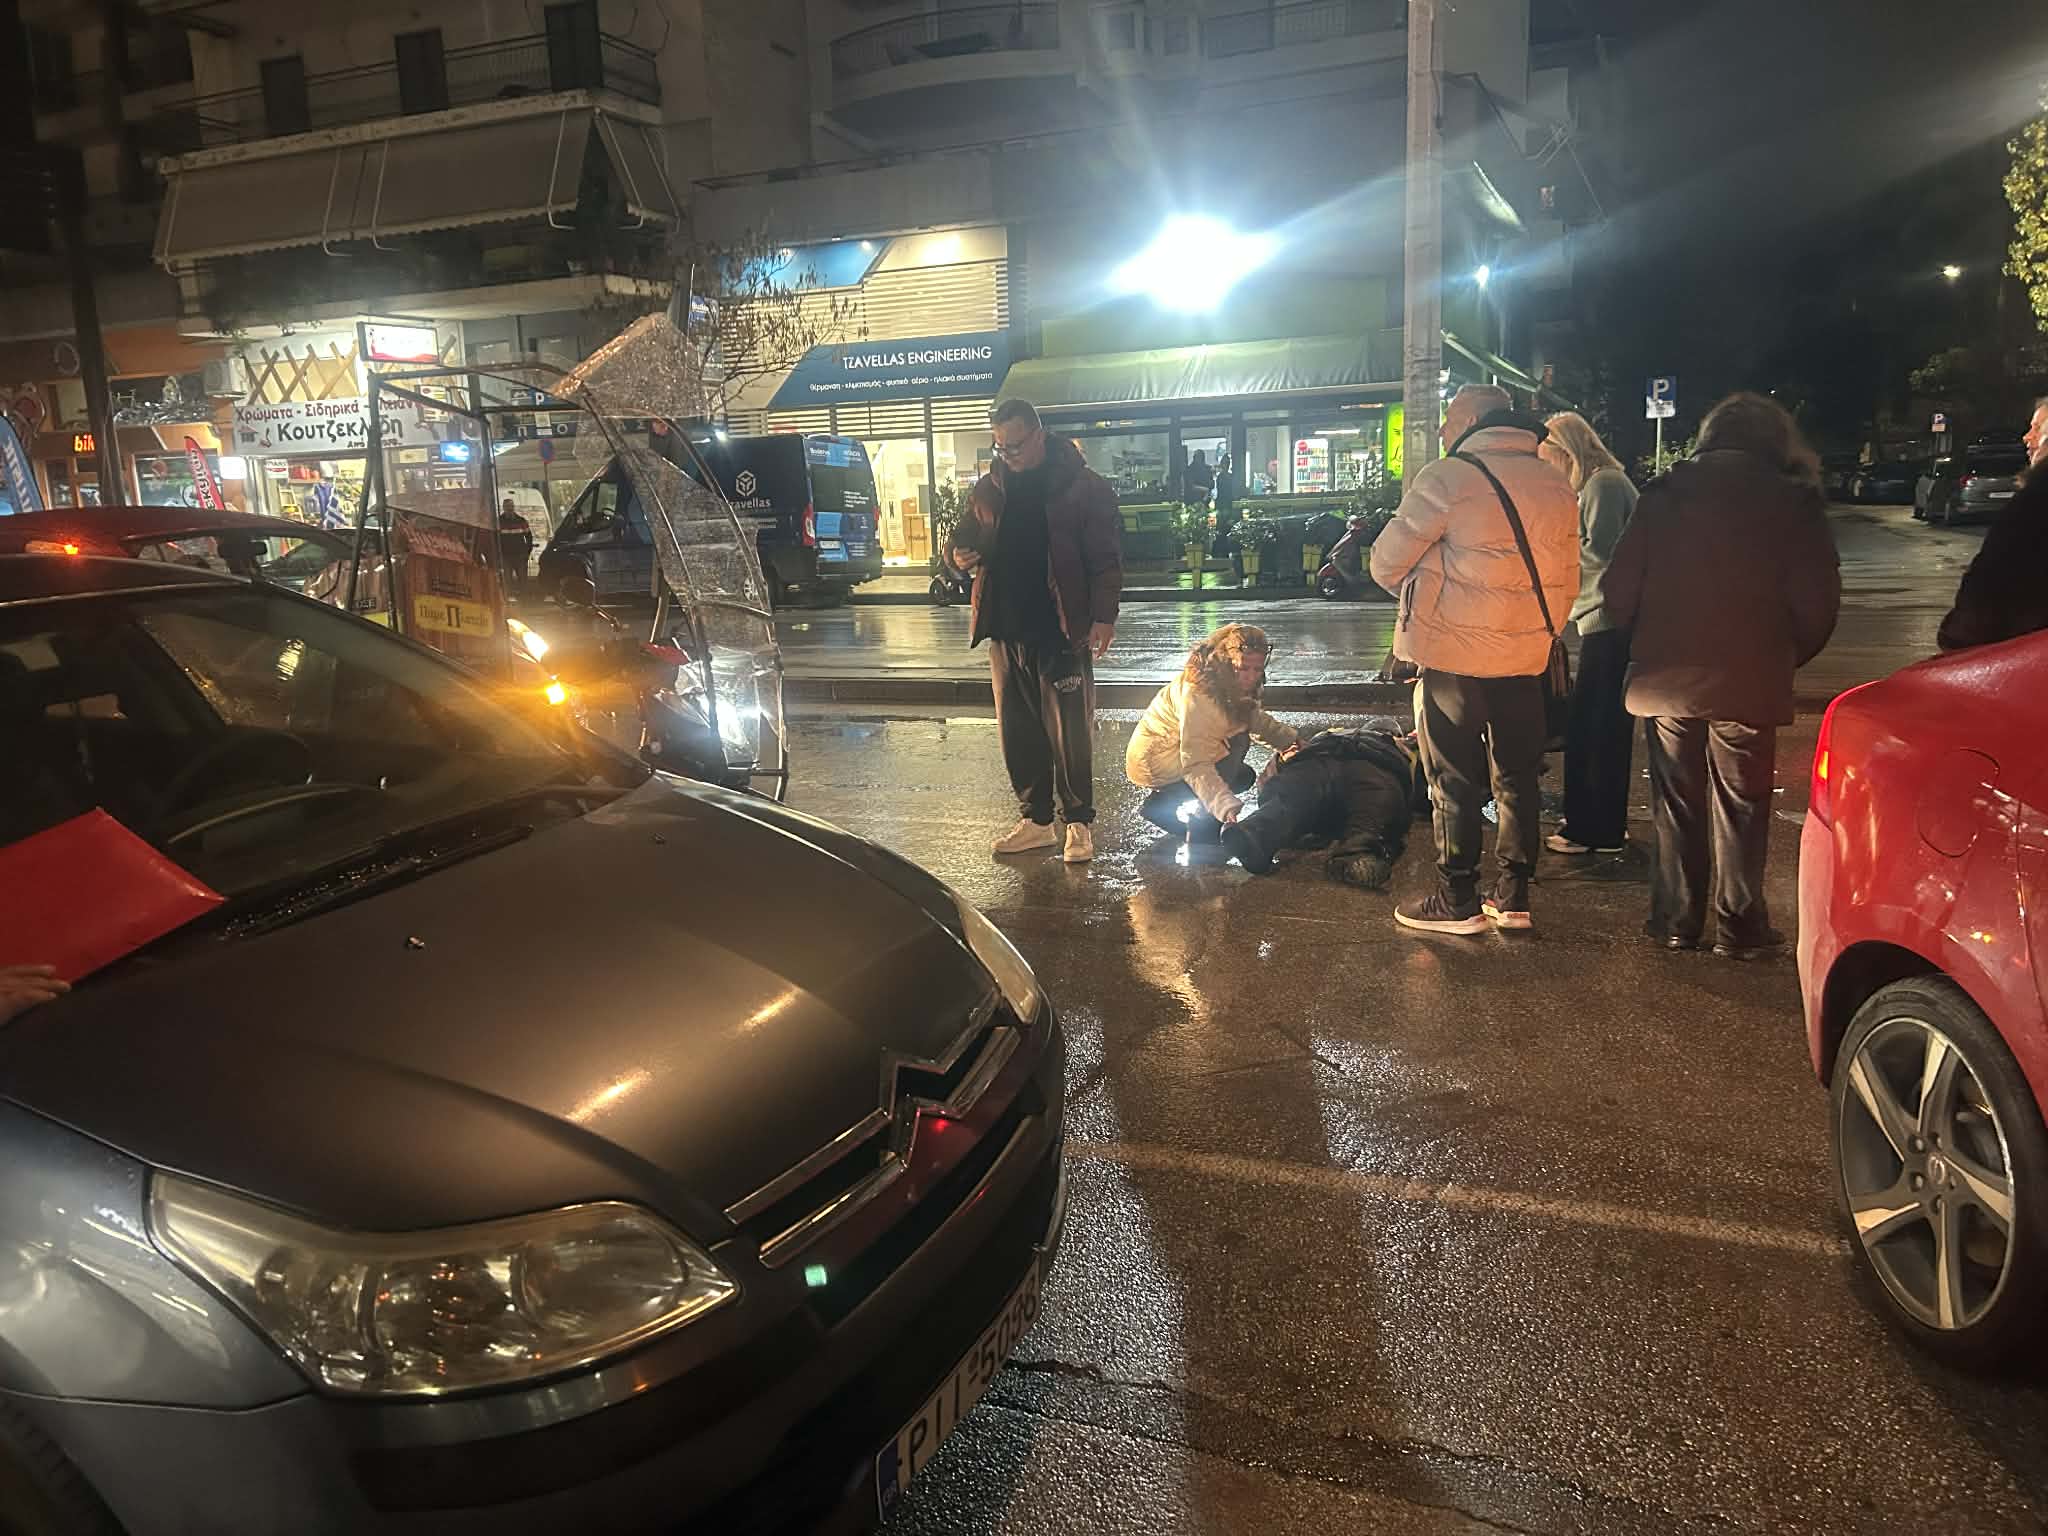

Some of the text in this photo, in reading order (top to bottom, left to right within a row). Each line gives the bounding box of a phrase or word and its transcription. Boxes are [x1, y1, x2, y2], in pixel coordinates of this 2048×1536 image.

[843, 346, 992, 369] TZAVELLAS ENGINEERING
[1653, 379, 1669, 400] P
[236, 407, 293, 424] Χρώματα
[305, 399, 359, 418] Σιδηρικά
[277, 414, 403, 444] Κουτζεκλδη
